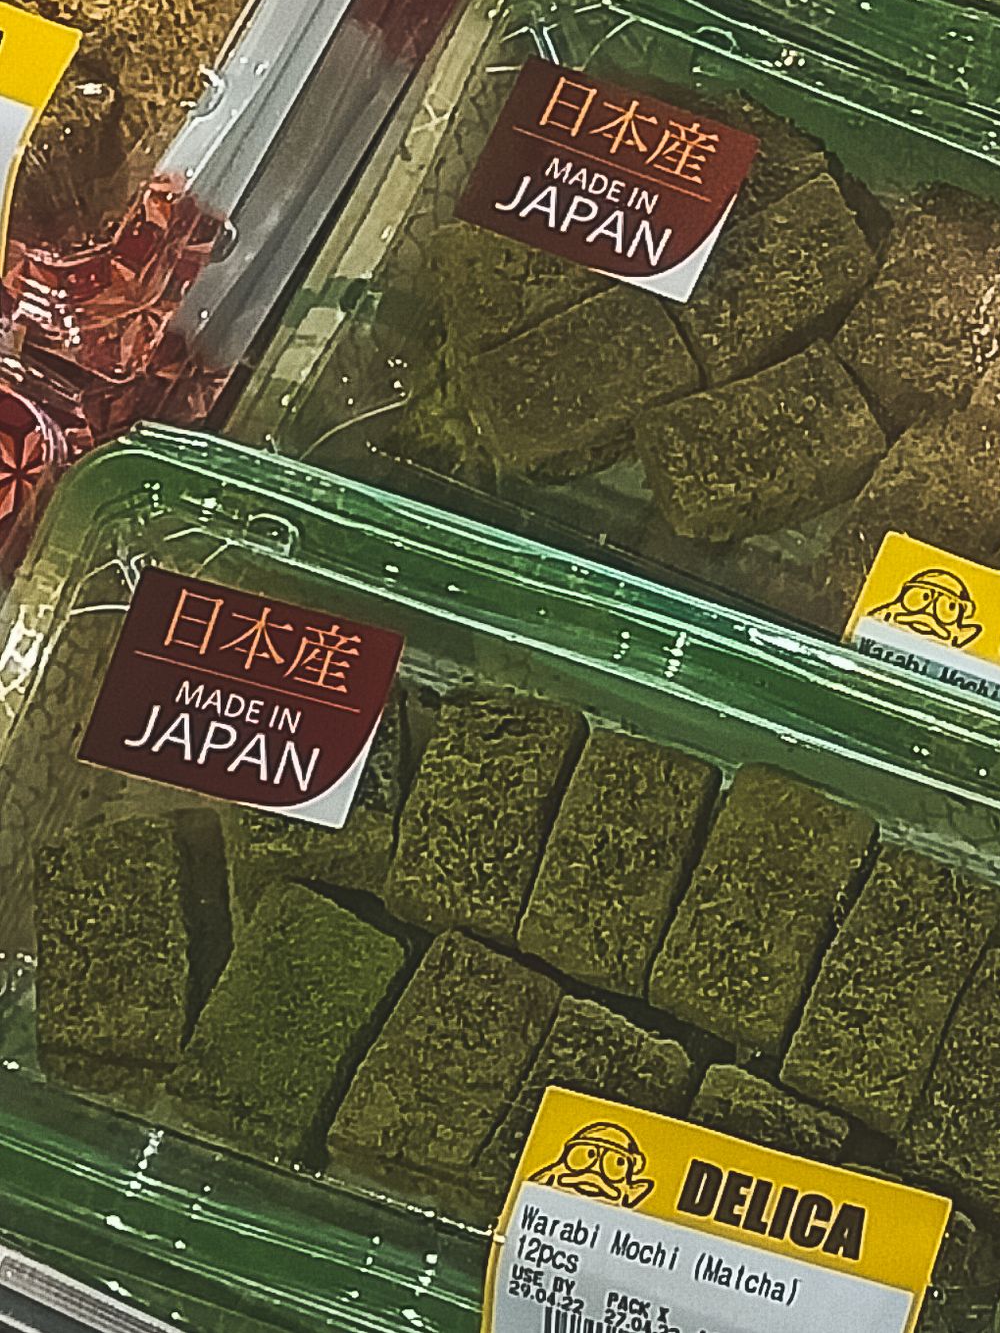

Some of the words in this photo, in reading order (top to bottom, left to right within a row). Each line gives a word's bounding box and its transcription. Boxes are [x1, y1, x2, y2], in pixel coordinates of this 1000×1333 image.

[539, 76, 720, 184] 日本産
[494, 175, 672, 266] JAPAN
[545, 157, 625, 202] MADE
[627, 186, 659, 215] IN
[164, 588, 362, 693] 日本産
[124, 704, 320, 792] JAPAN
[175, 680, 265, 724] MADE
[268, 705, 302, 734] IN
[677, 1158, 867, 1261] DELICA
[508, 1280, 584, 1313] 29.04.22
[512, 1263, 544, 1287] USE
[553, 1276, 576, 1296] BY
[607, 1292, 651, 1319] PACK
[518, 1234, 579, 1274] 12pcs
[521, 1204, 600, 1248] Warabi
[610, 1230, 680, 1270] Mochi
[694, 1250, 800, 1306] (Matcha)
